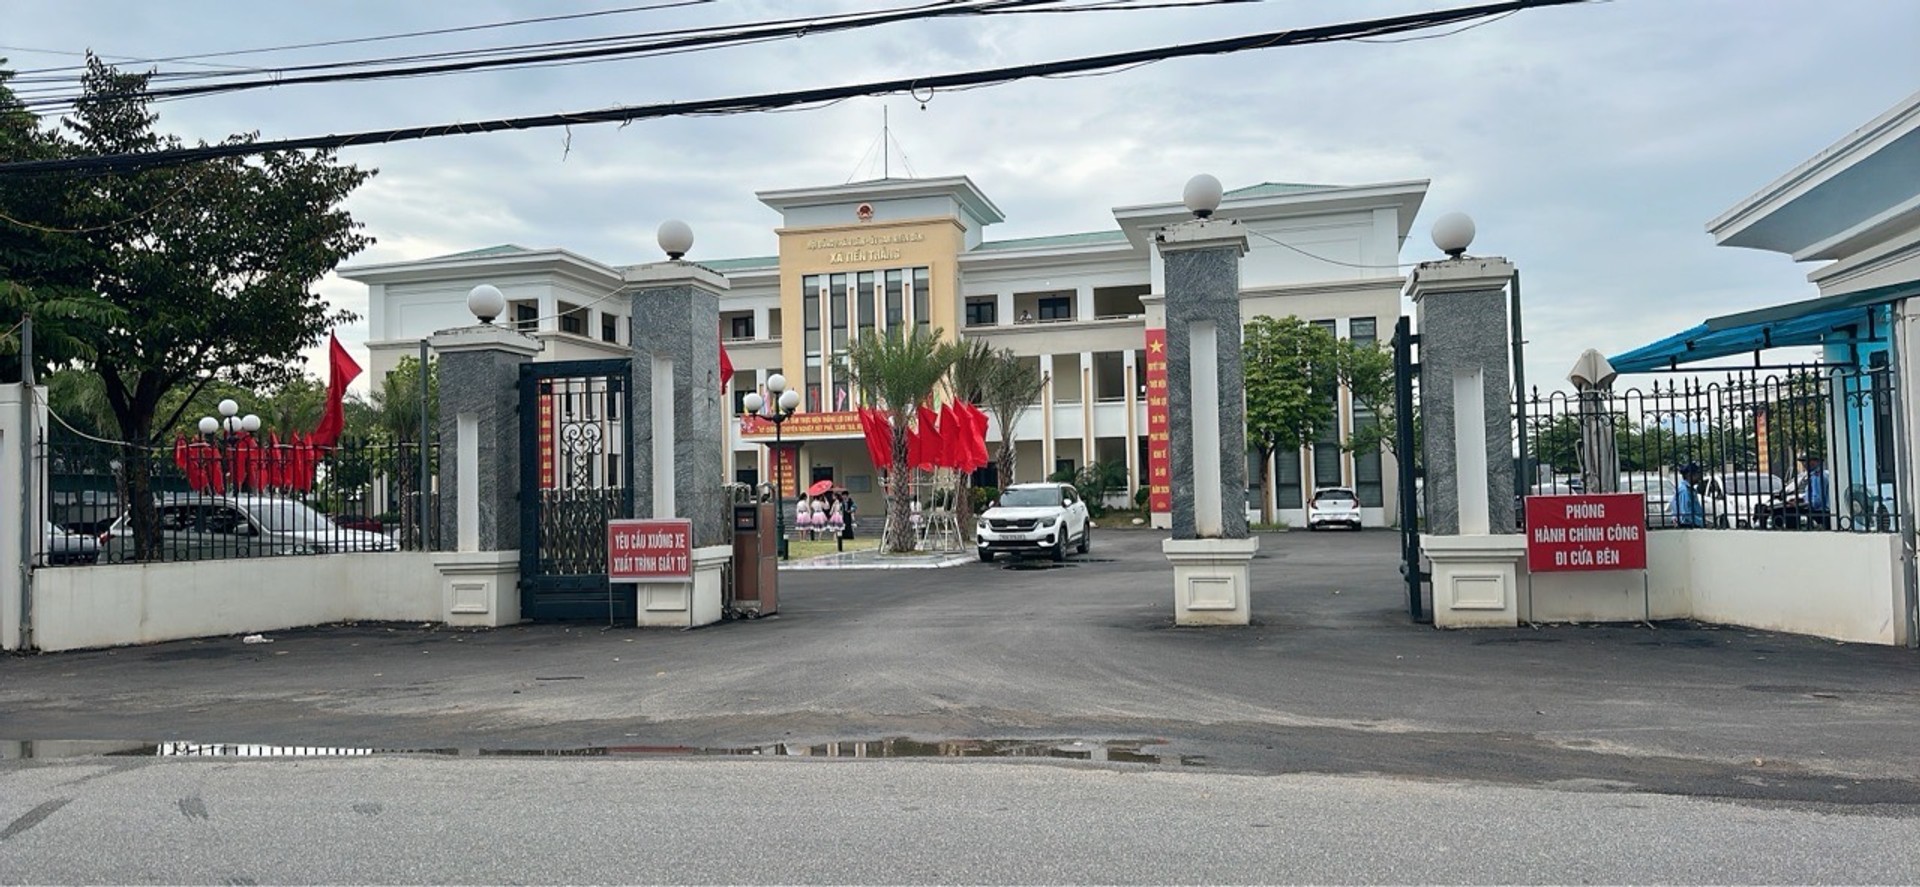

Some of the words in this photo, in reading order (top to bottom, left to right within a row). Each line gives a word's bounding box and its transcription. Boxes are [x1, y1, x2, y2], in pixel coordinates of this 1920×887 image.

[1565, 501, 1605, 519] PHÒNG
[615, 531, 630, 549] YÊU
[647, 528, 674, 549] XUỐNG
[674, 533, 686, 549] XE
[1535, 525, 1566, 543] HÀNH
[1568, 524, 1604, 542] CHÍNH
[1606, 523, 1639, 541] CÔNG
[613, 552, 633, 572] XUẤT
[634, 554, 657, 572] TRÌNH
[658, 551, 675, 571] GIẤY
[676, 552, 687, 571] TỜ
[1555, 551, 1567, 566] ĐI
[1570, 544, 1594, 566] CỬA
[1595, 547, 1620, 565] BÊN
